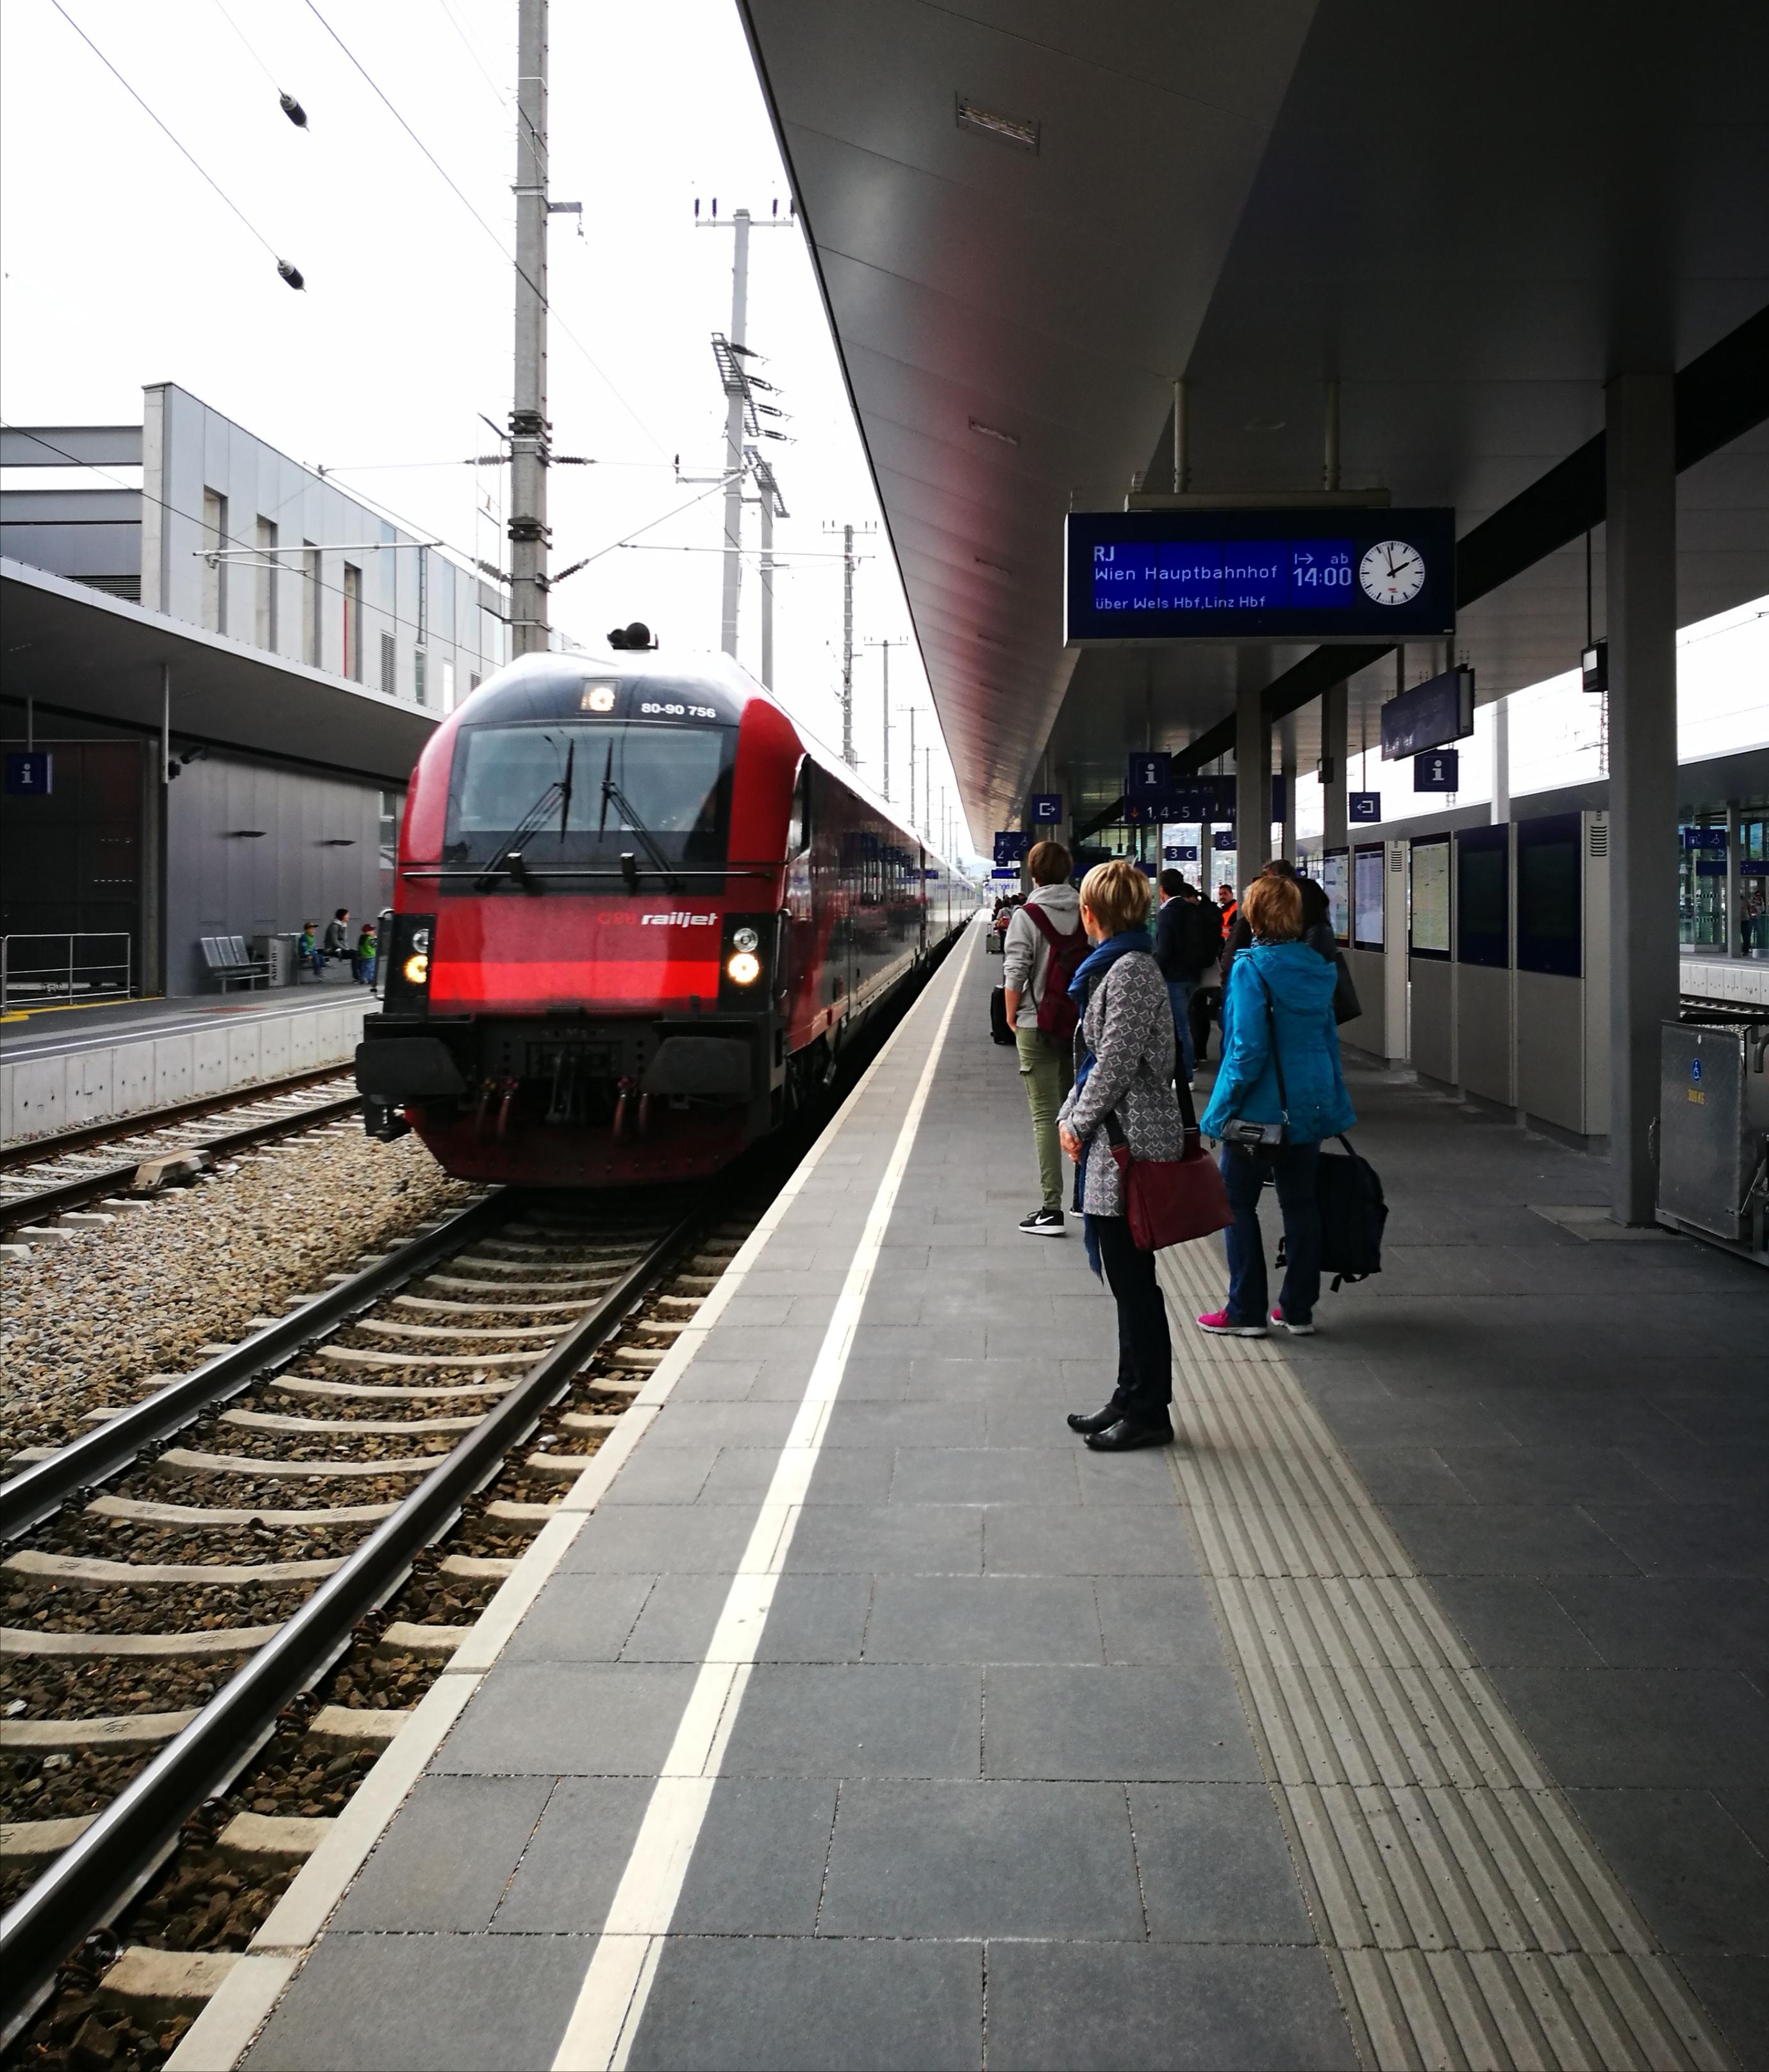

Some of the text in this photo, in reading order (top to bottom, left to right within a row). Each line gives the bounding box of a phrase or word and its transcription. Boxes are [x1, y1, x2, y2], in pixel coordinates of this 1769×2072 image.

[1093, 546, 1115, 562] RJ
[1330, 553, 1349, 564] ab
[1095, 565, 1277, 582] Wien Hauptbahnhof
[1293, 567, 1352, 586] 14:00
[1095, 597, 1129, 609] über
[1134, 597, 1169, 608] Wels
[1239, 596, 1266, 608] Hbf
[641, 703, 717, 718] 80-90 756
[641, 912, 718, 928] railjet
